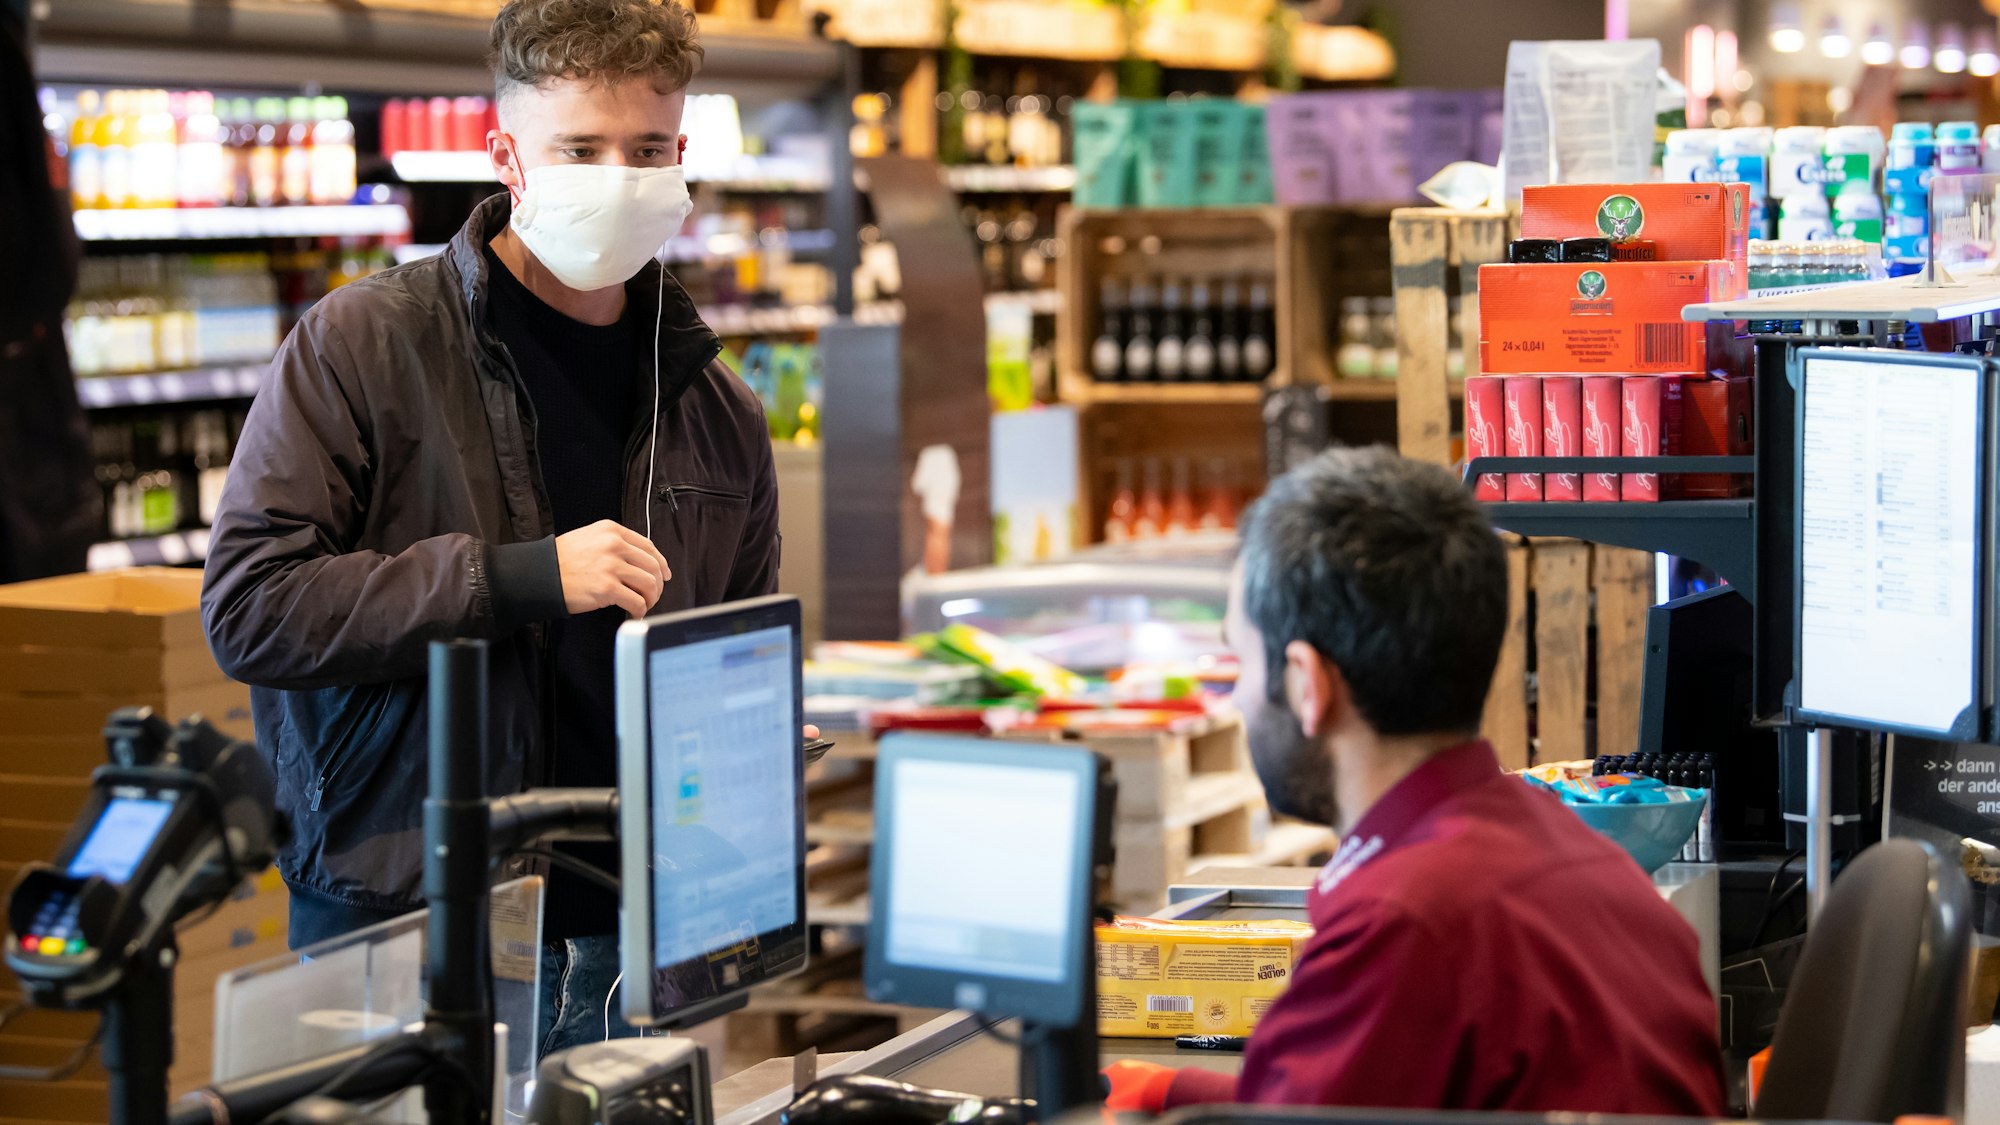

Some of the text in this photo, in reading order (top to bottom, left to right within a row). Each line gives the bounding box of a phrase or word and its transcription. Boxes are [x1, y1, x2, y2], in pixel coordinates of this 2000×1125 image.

[1502, 341, 1512, 351] 24
[1956, 759, 1994, 773] dann
[1938, 778, 1964, 793] der
[1258, 968, 1286, 980] GOLDEN
[1259, 964, 1276, 972] TOAST
